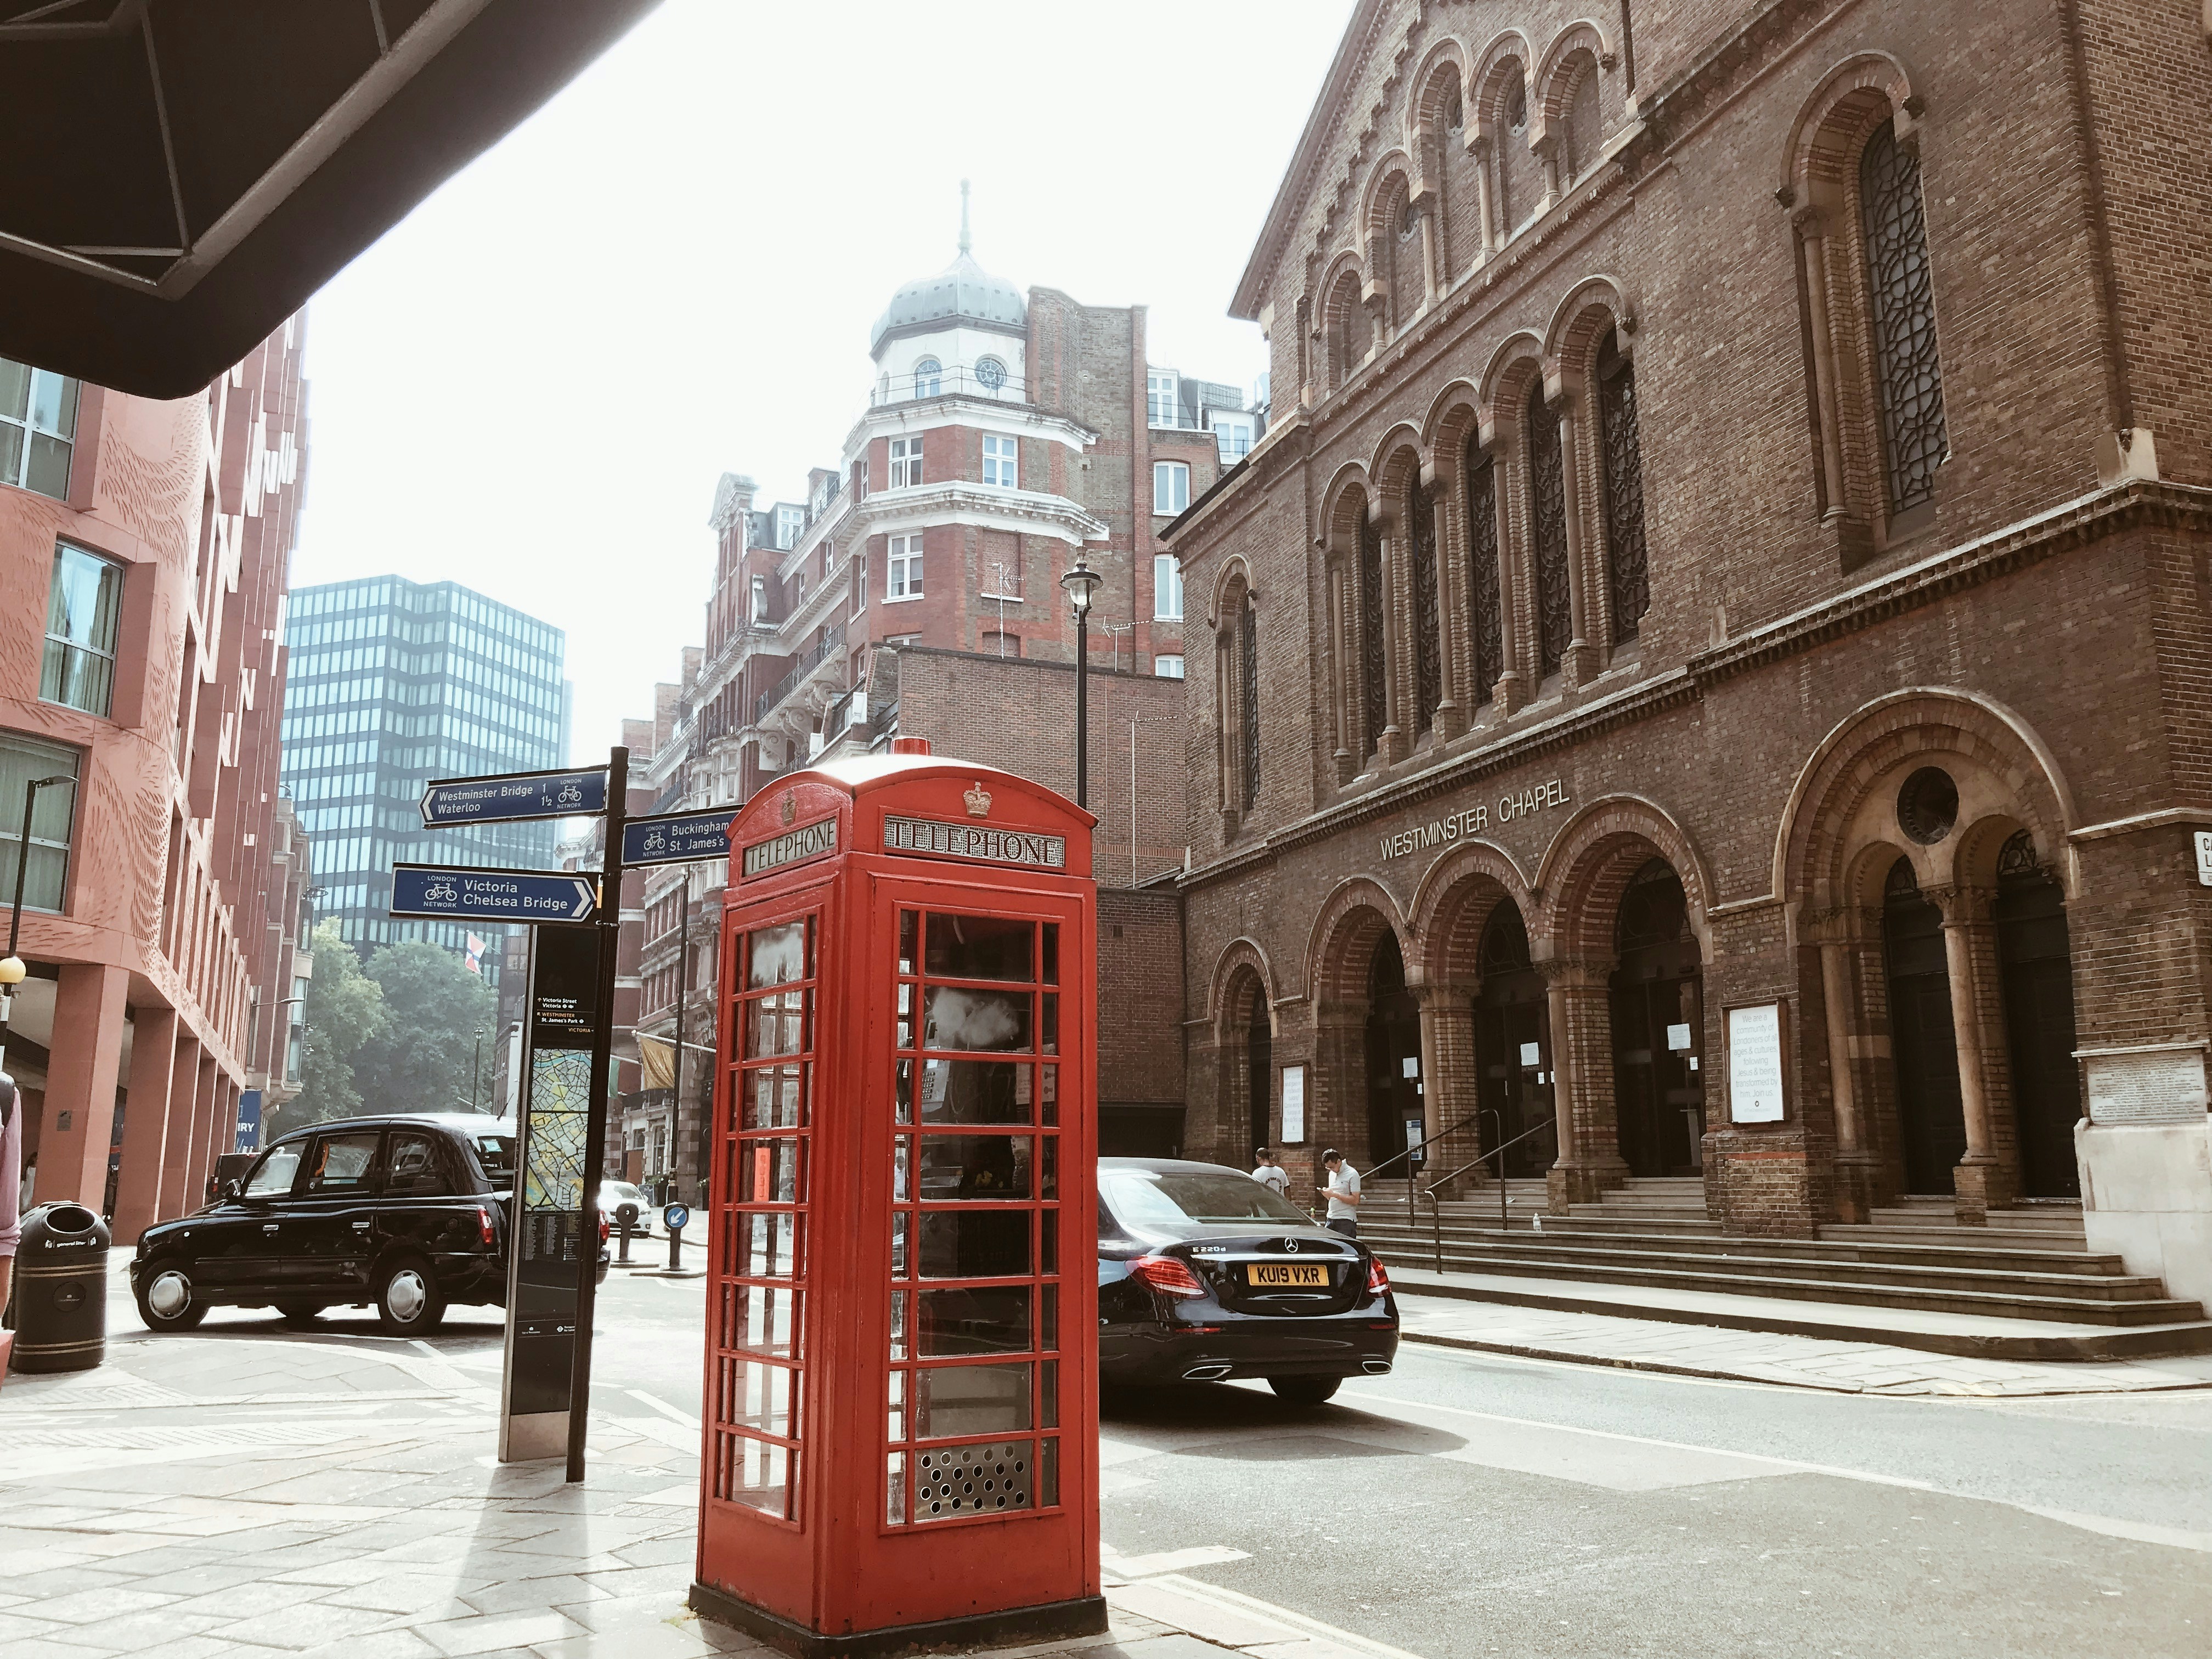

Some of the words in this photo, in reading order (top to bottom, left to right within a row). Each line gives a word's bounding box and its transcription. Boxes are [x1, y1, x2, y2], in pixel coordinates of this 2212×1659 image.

[439, 789, 497, 802] Westminster
[501, 786, 533, 797] Bridge
[542, 783, 546, 793] 1
[438, 803, 481, 814] Waterloo
[1380, 805, 1488, 860] WESTMINSTER
[1499, 779, 1570, 822] CHAPEL
[672, 821, 729, 836] Buckingham
[670, 840, 683, 851] St.
[687, 836, 725, 850] James's
[748, 822, 836, 872] TELEPHONE
[890, 821, 1057, 865] TELEPHONE
[465, 879, 518, 893] Victoria
[463, 894, 518, 907] Chelsea
[523, 896, 568, 911] Bridge
[1737, 1025, 1767, 1034] community
[1768, 1023, 1774, 1031] of
[1734, 1036, 1763, 1045] Londoners
[1734, 1048, 1747, 1057] ages
[1743, 1057, 1769, 1066] following
[1759, 1068, 1776, 1076] being
[1736, 1077, 1769, 1087] transformed
[1770, 1078, 1778, 1086] by
[1257, 1267, 1289, 1283] KU19
[1293, 1267, 1321, 1283] VXR
